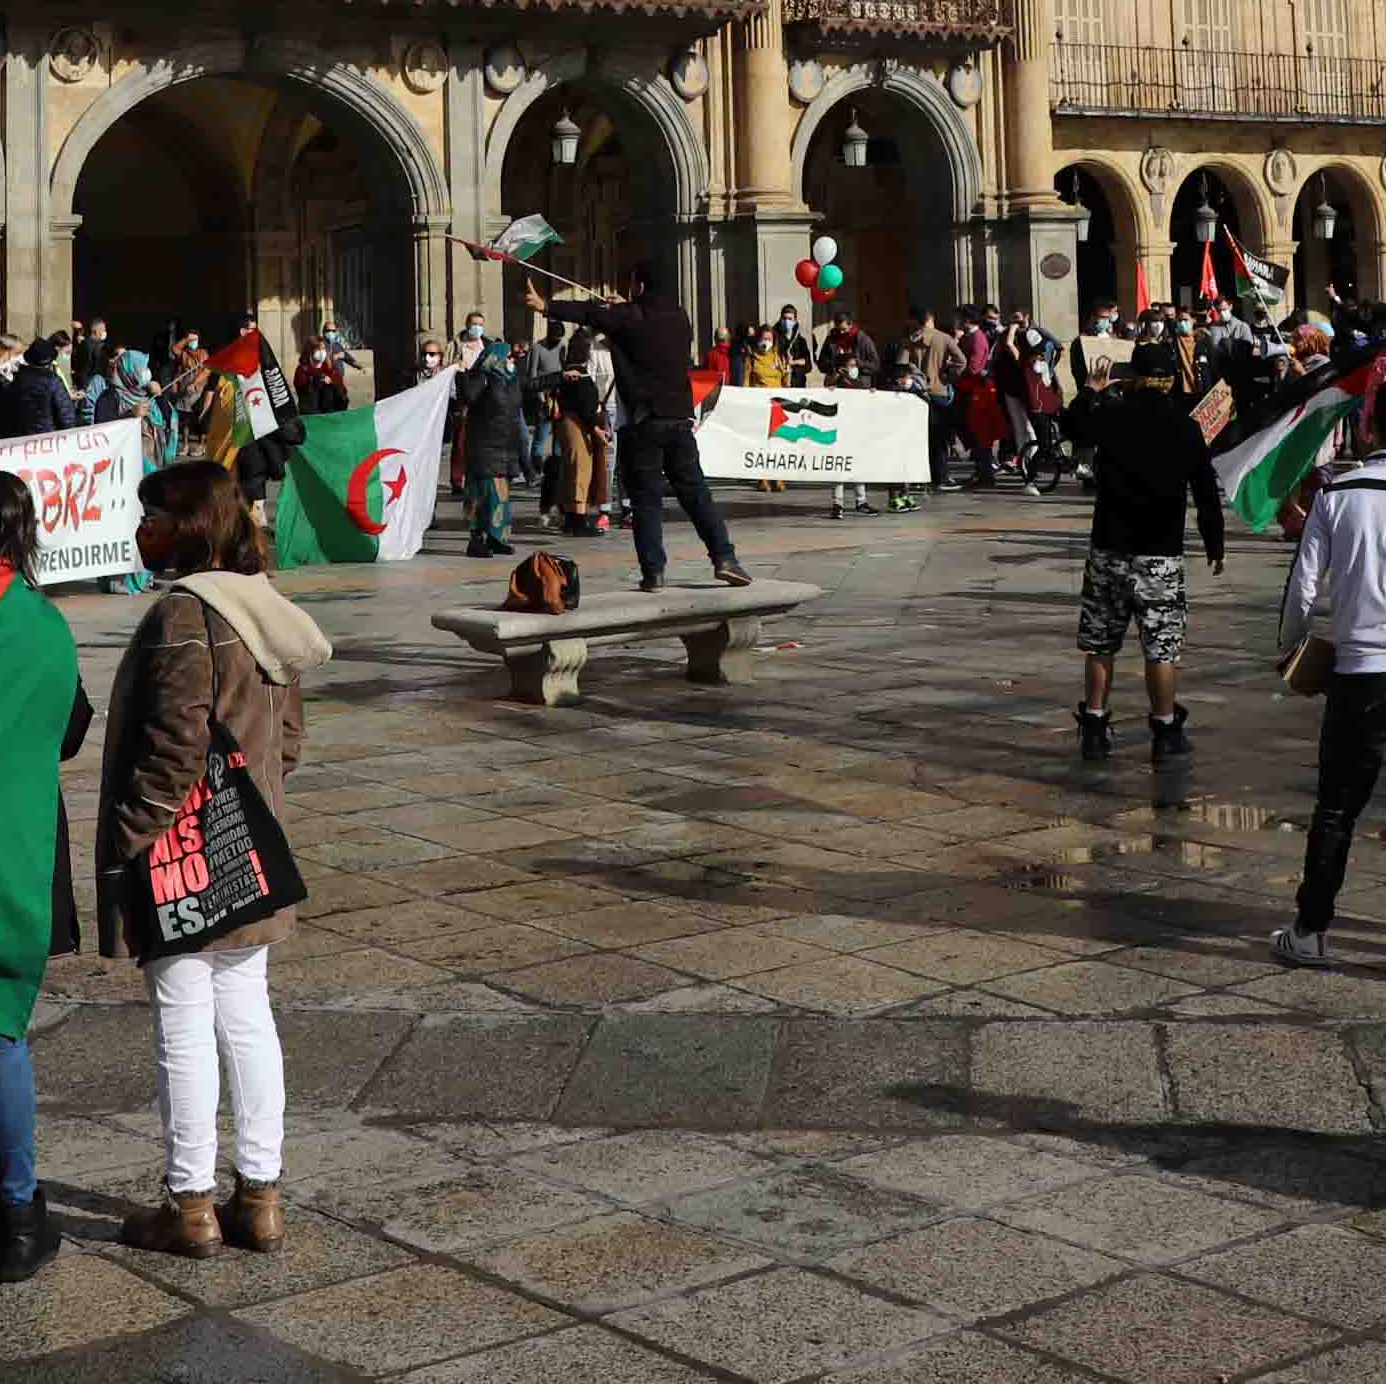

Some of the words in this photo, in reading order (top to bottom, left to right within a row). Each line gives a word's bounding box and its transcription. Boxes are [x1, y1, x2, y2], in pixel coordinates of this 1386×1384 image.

[264, 367, 290, 408] SAHARA
[77, 430, 110, 450] un
[743, 451, 807, 470] SAHARA
[812, 455, 854, 471] LIBRE
[16, 457, 125, 534] BRE!!
[37, 540, 131, 574] RENDIRME
[150, 852, 210, 905] MO
